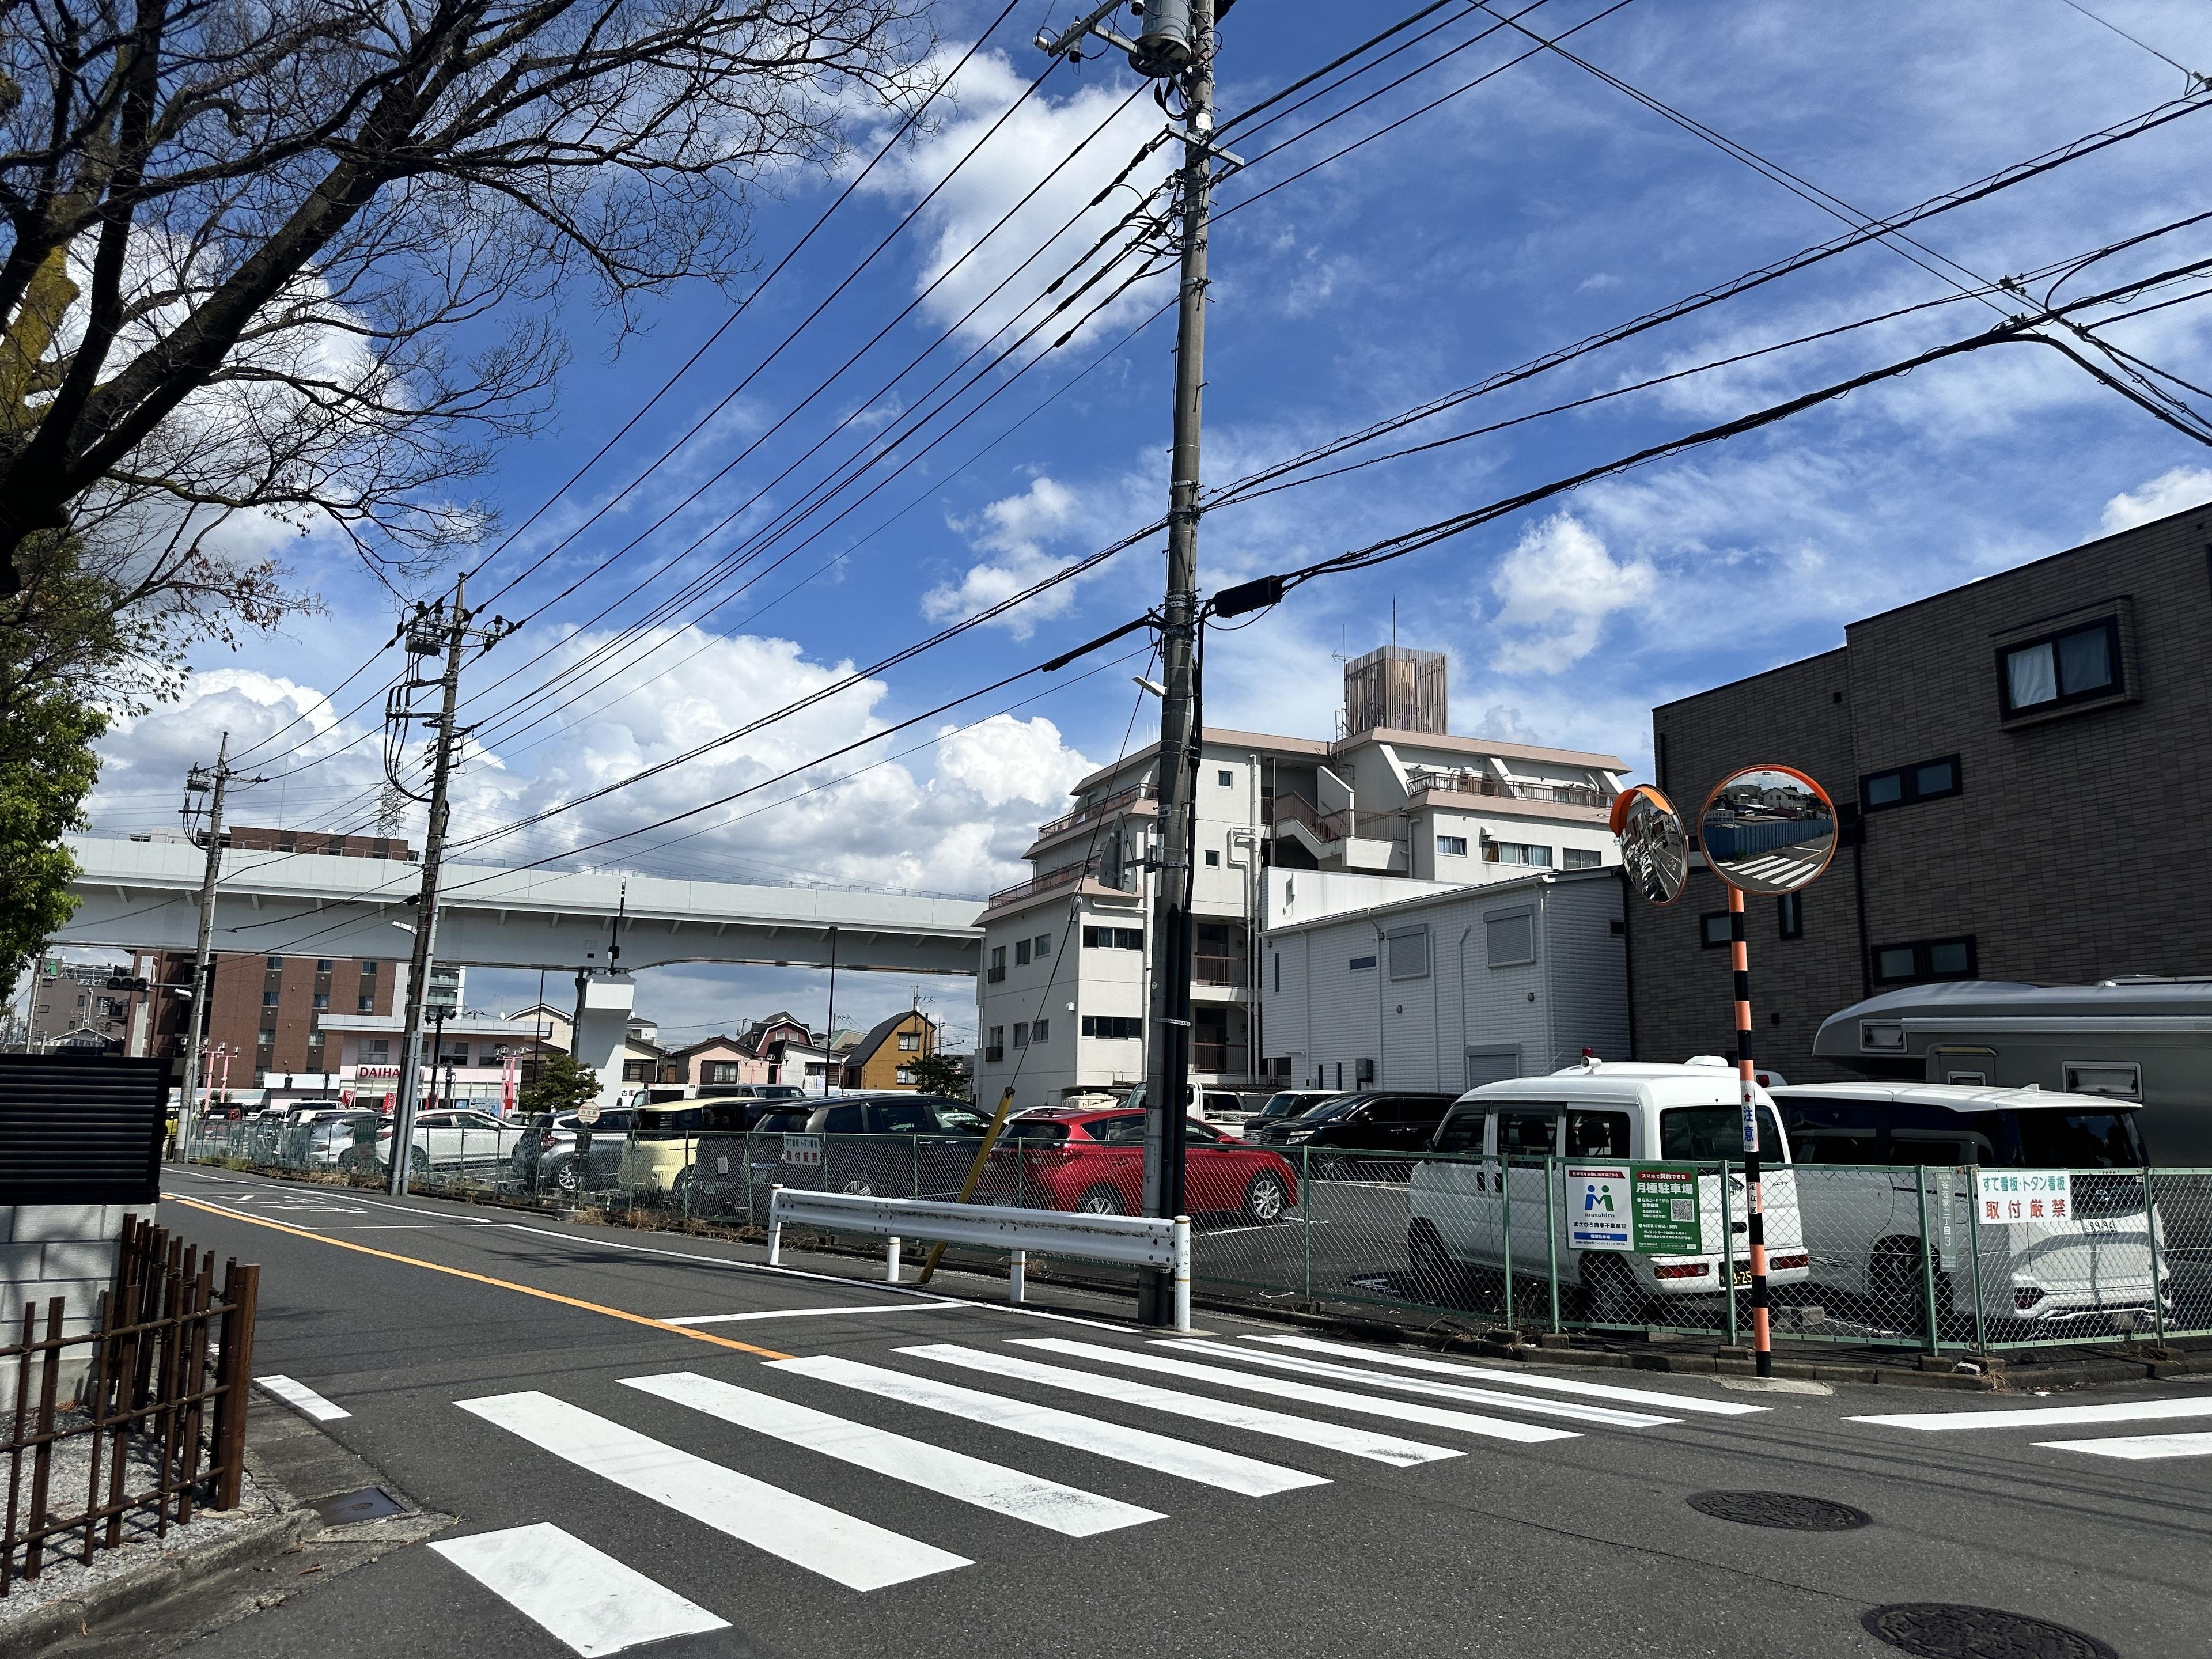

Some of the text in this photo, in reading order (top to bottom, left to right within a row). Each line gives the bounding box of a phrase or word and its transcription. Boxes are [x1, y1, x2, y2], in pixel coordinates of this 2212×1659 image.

[1743, 1105, 1754, 1142] 注意
[1636, 1182, 1694, 1195] 月極駐車場
[1983, 1176, 2065, 1192] すて看板・トタン看板
[1985, 1199, 2066, 1220] 取付厳禁
